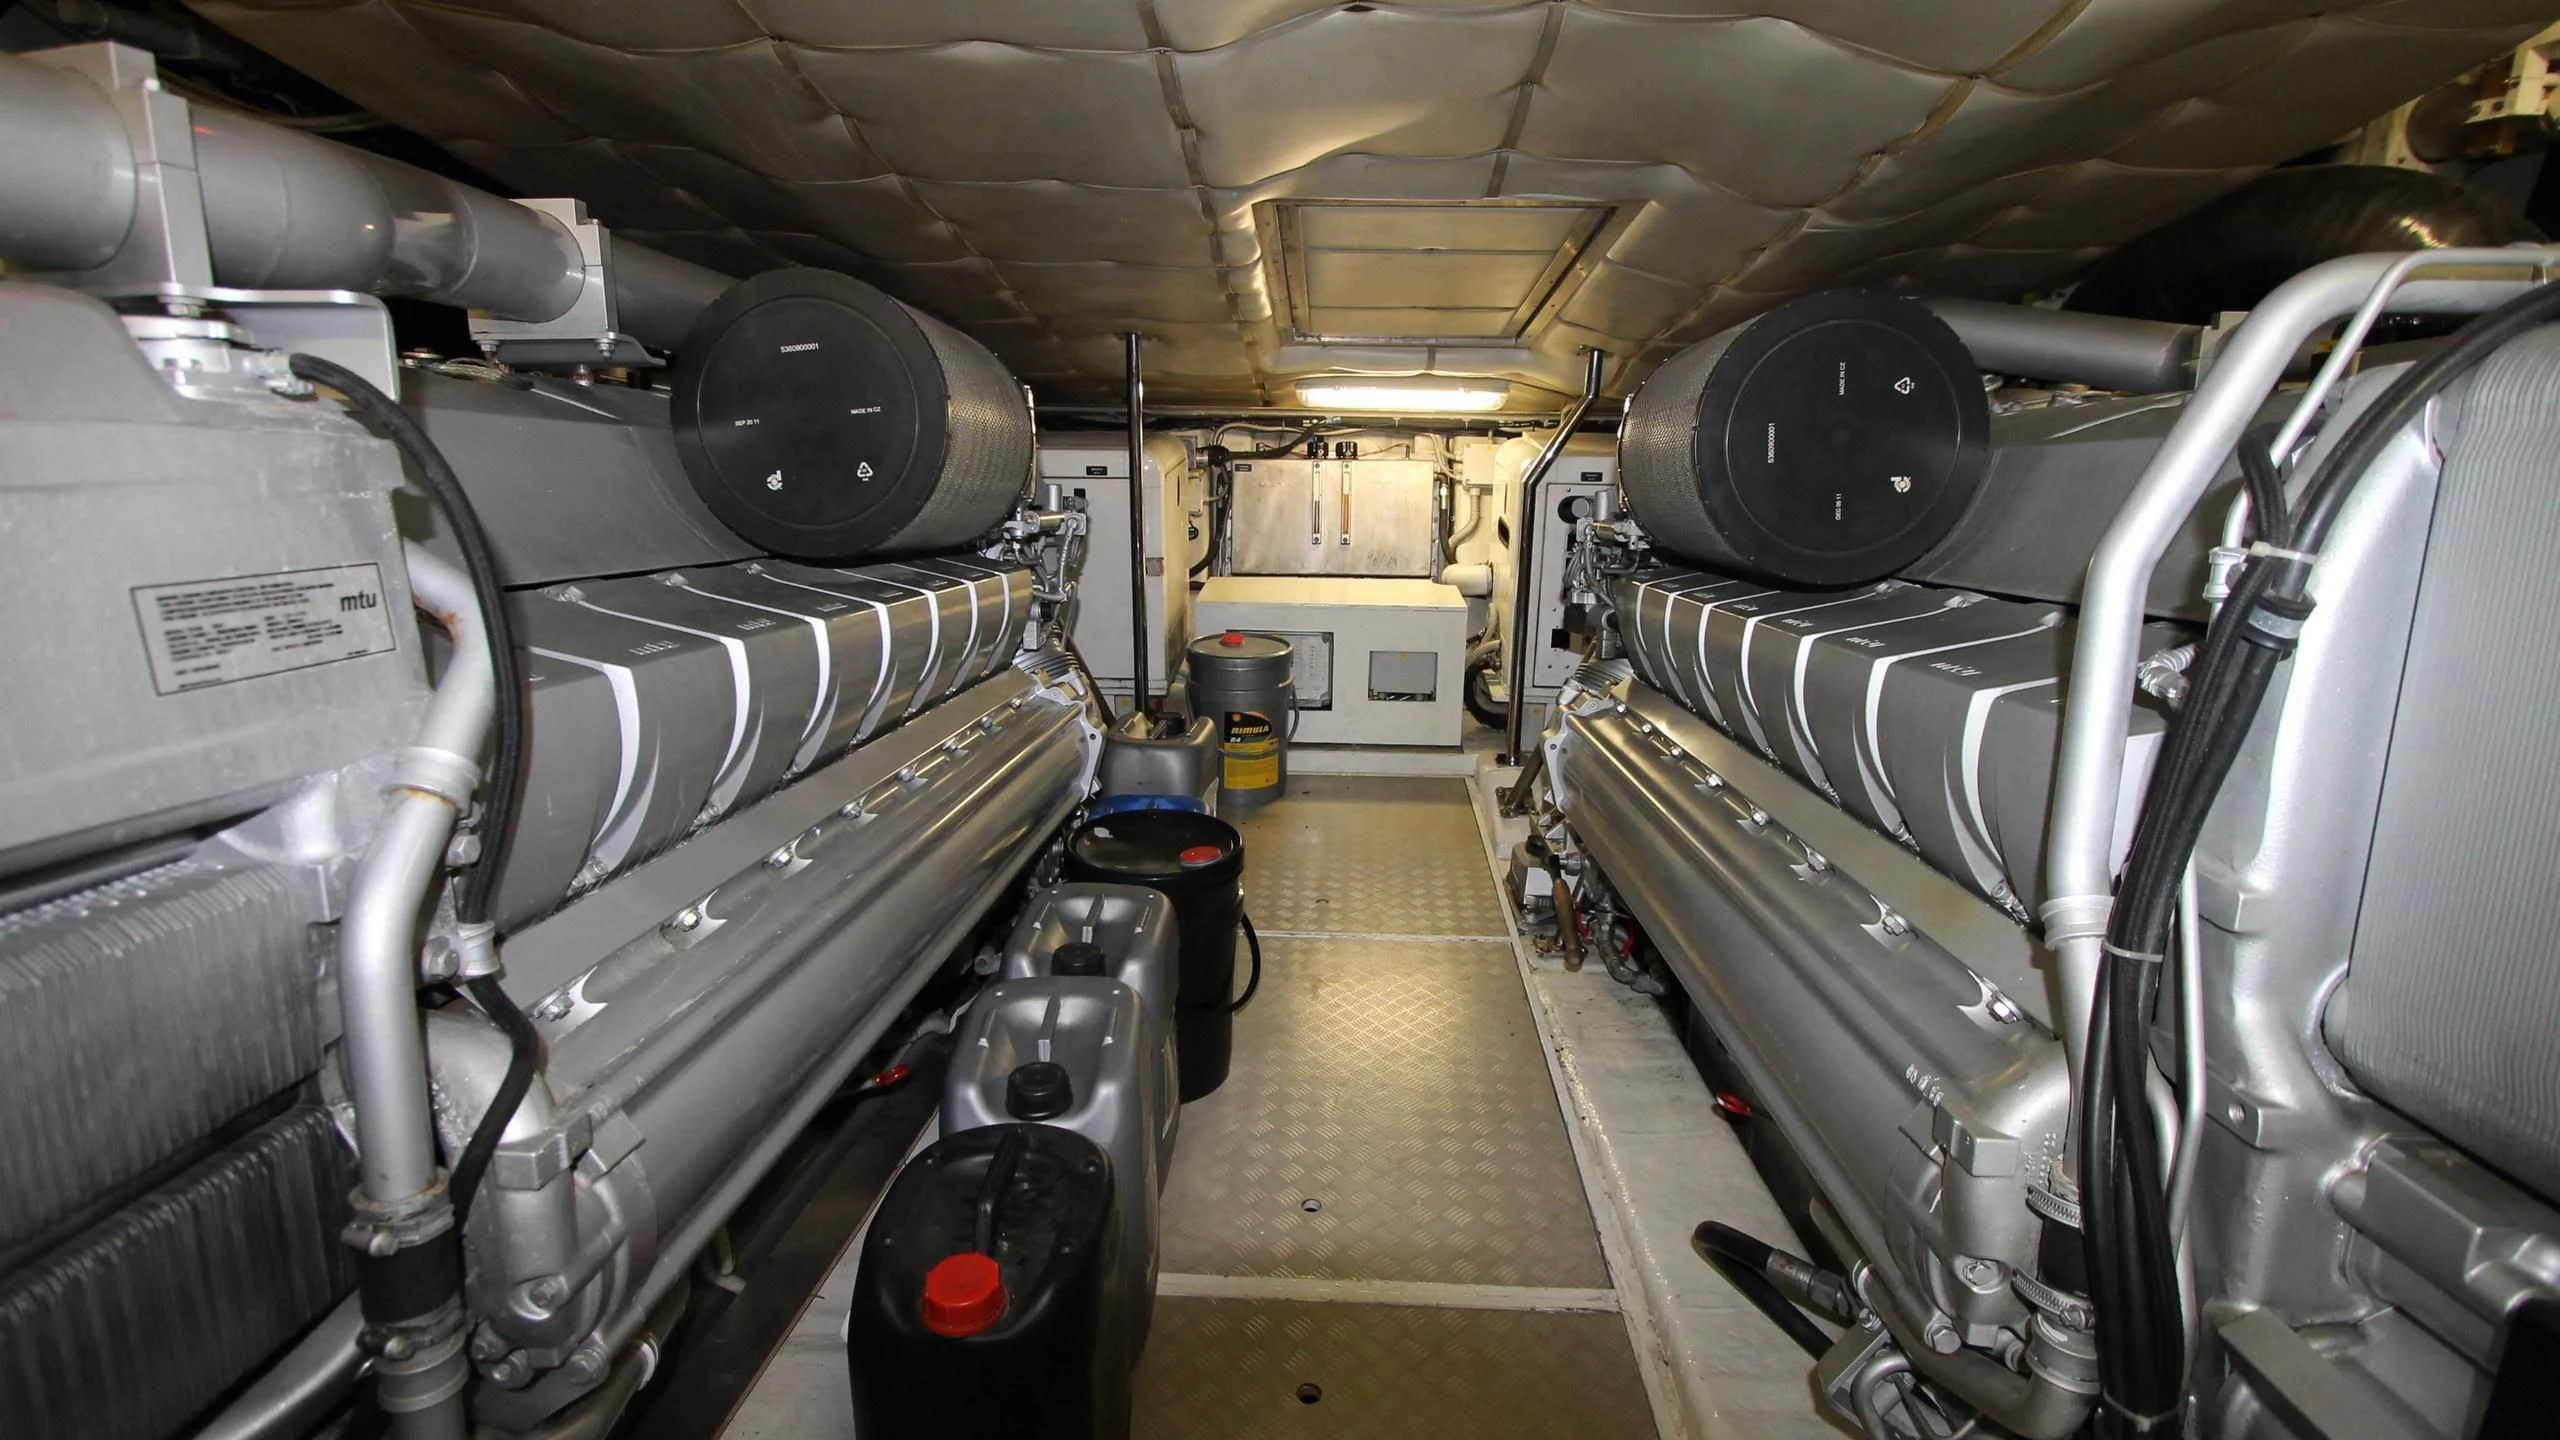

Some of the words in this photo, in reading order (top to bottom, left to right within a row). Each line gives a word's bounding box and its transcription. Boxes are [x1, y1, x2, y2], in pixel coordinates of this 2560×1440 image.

[850, 407, 866, 415] MADE
[340, 590, 377, 612] mtu
[1231, 725, 1269, 735] RIMULA
